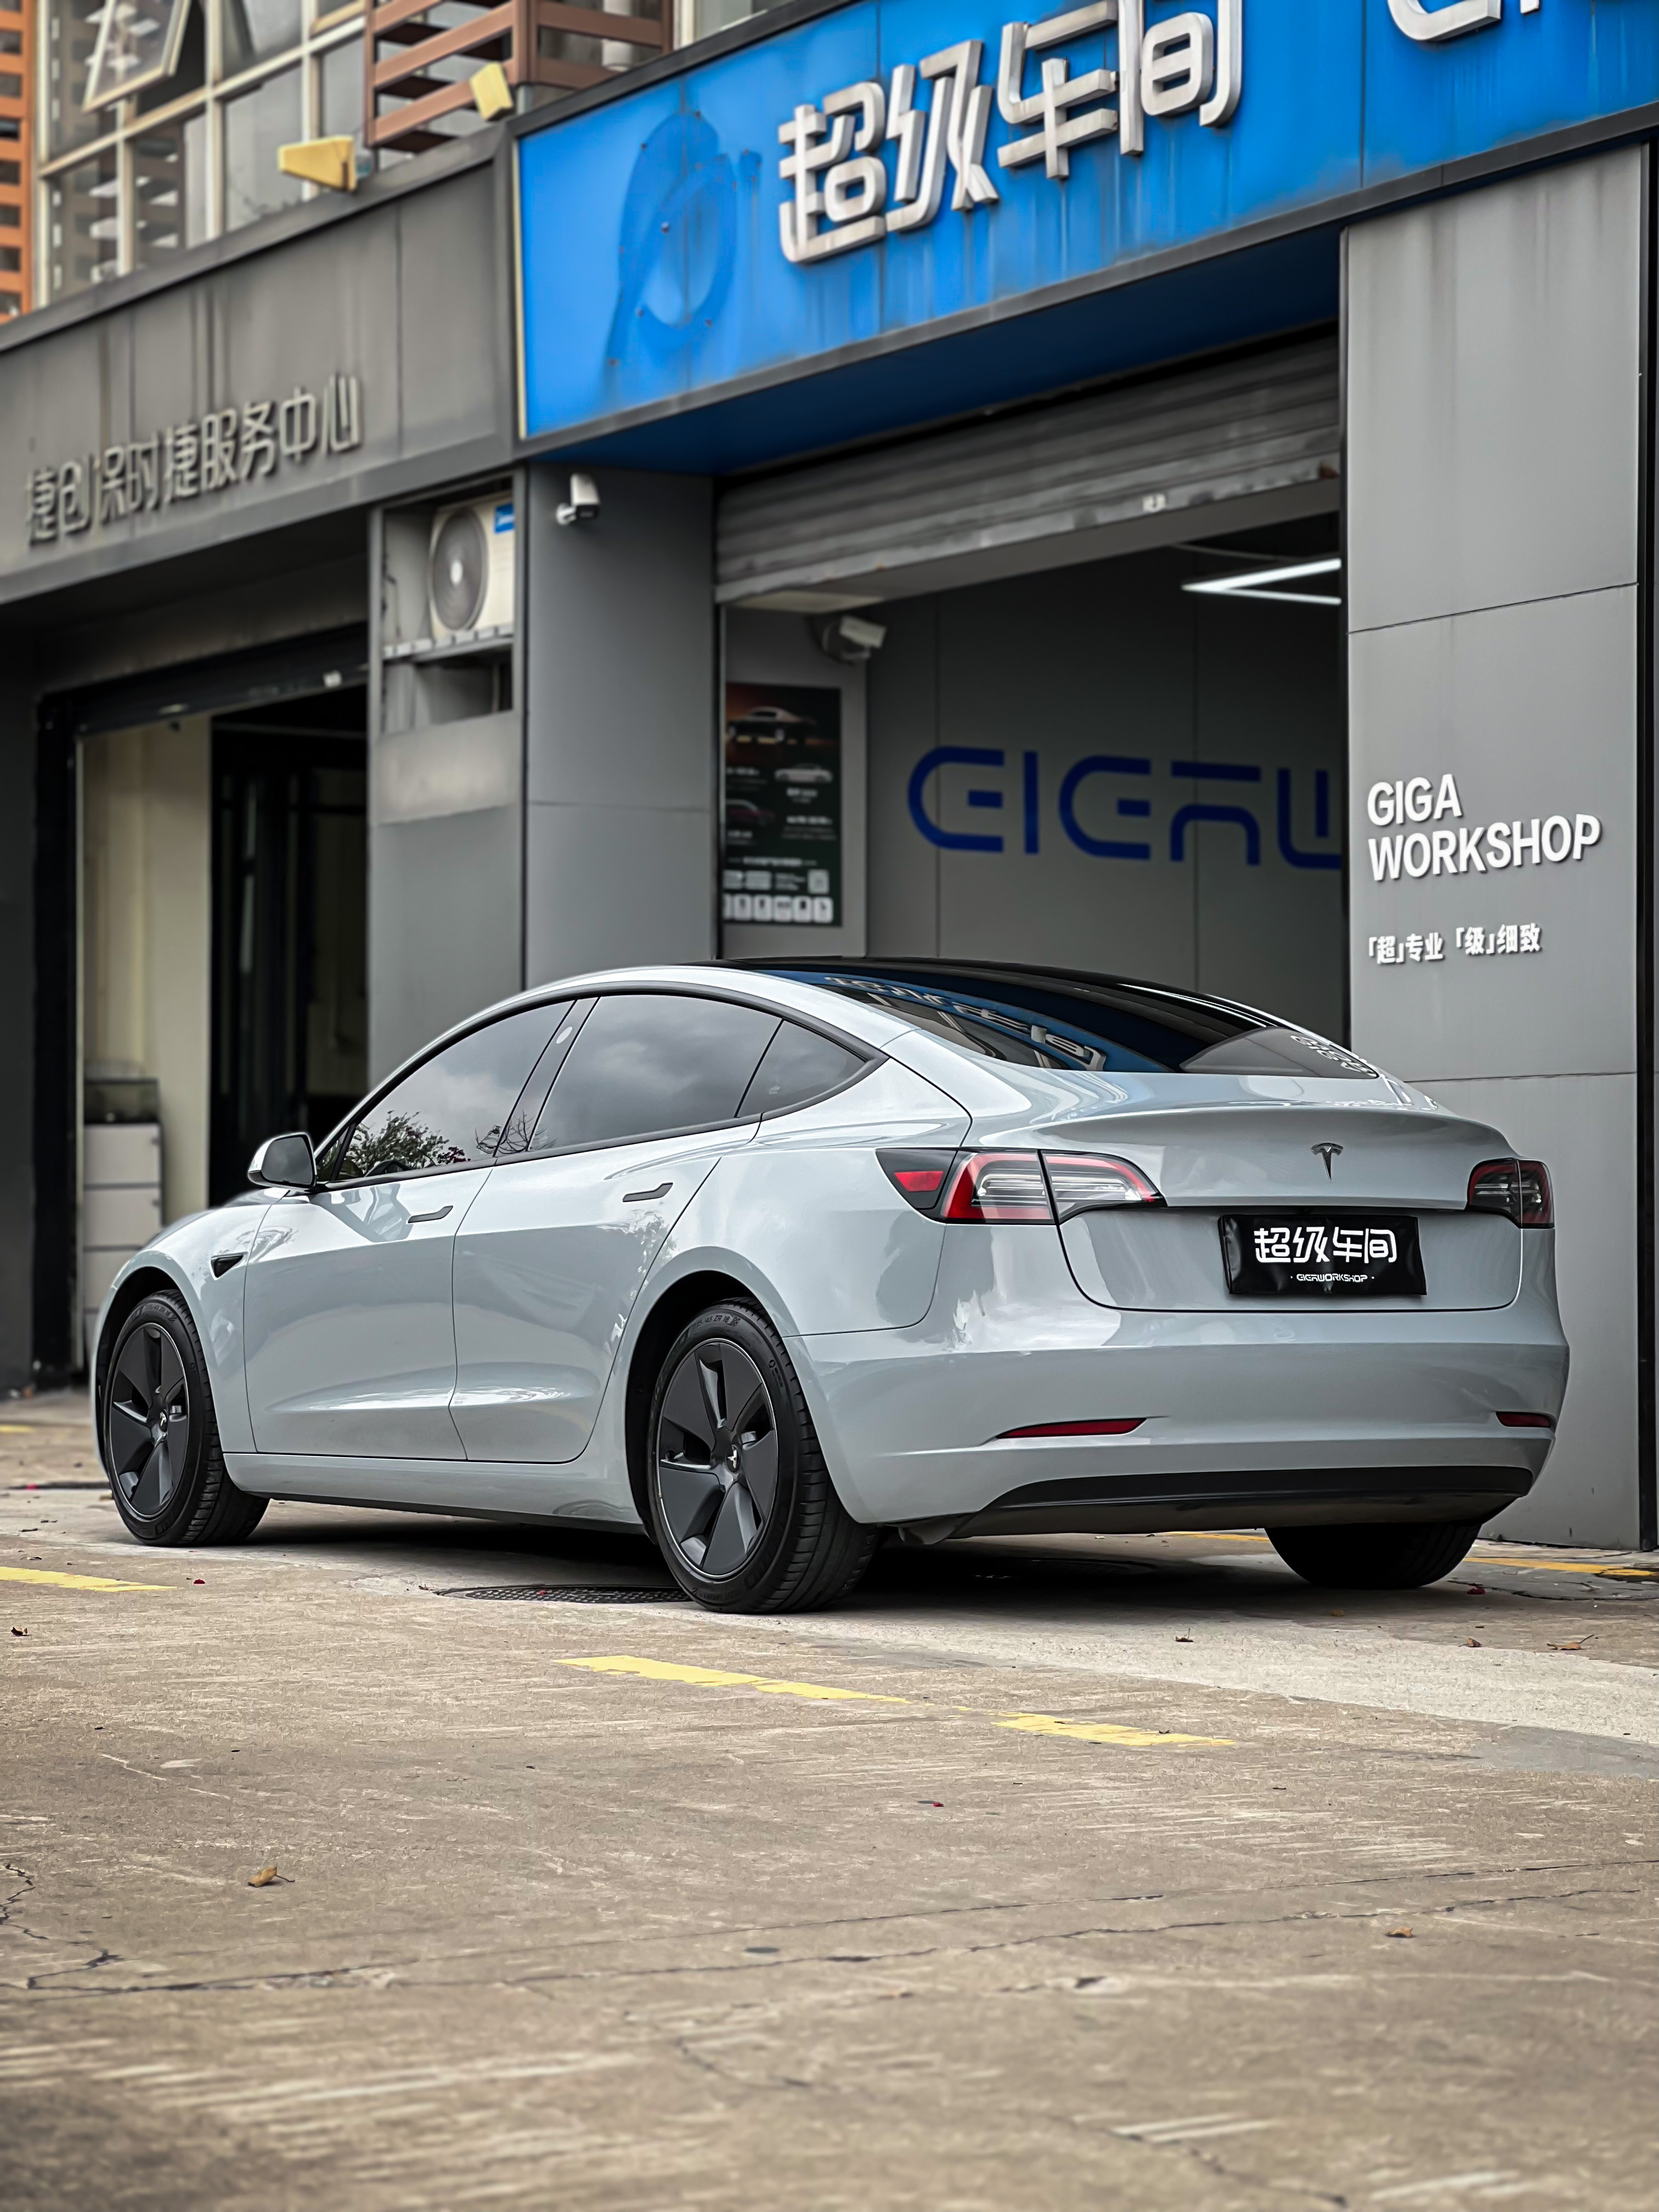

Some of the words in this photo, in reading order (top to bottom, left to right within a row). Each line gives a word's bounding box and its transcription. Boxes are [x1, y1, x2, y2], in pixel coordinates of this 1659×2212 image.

[778, 0, 1243, 262] 超级车间
[1367, 774, 1463, 826] GIGA
[1368, 814, 1601, 882] WORKSHOP
[1254, 1226, 1397, 1263] 超级车间
